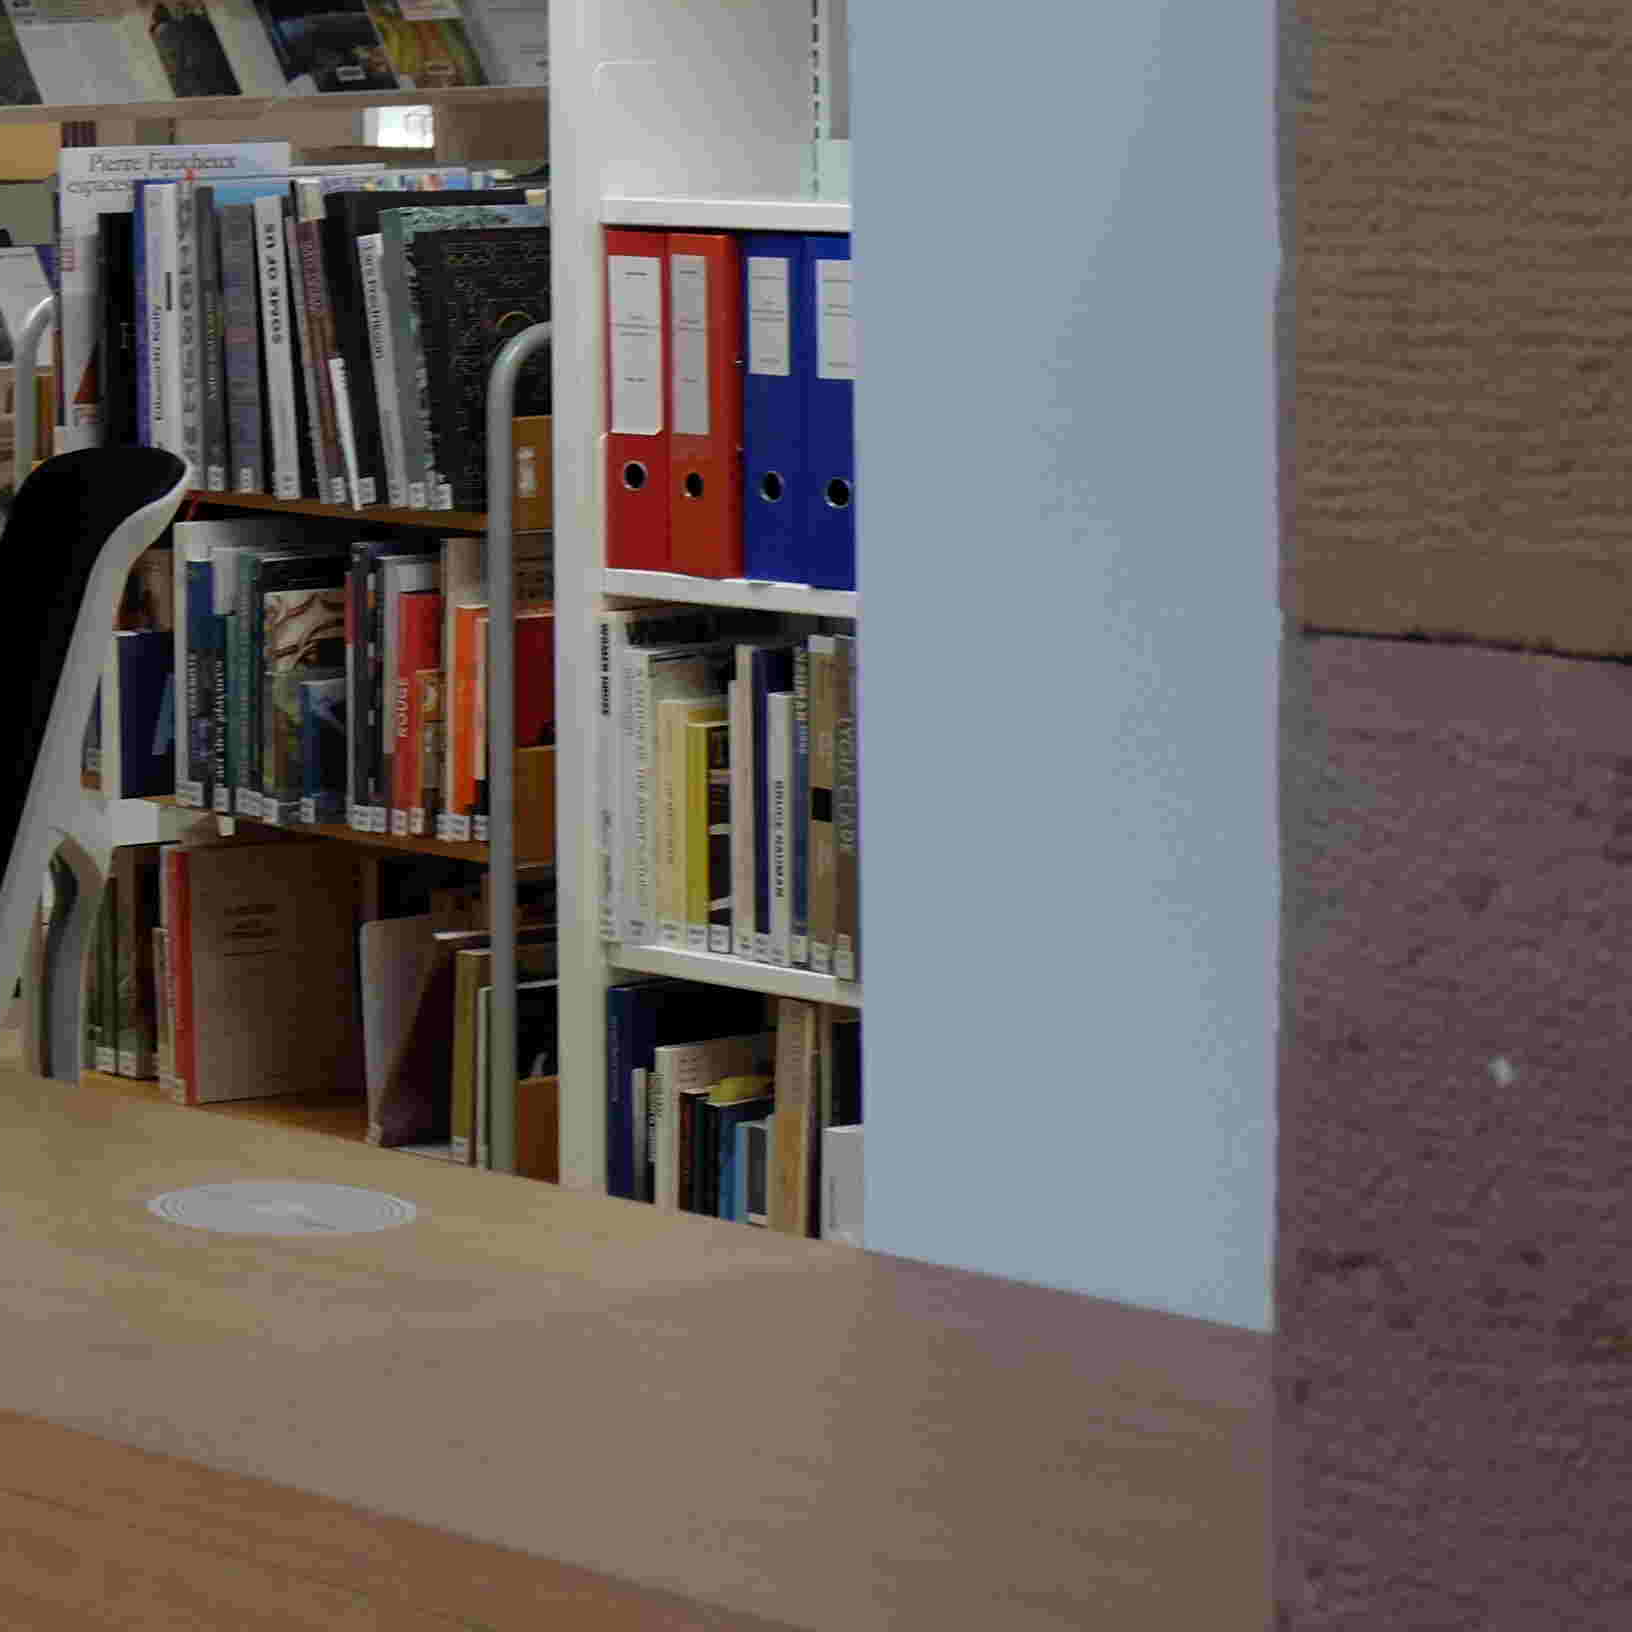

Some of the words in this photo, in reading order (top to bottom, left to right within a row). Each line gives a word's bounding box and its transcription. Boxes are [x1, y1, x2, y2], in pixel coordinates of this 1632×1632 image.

[89, 153, 142, 173] Pierre
[265, 223, 277, 248] US
[267, 256, 279, 280] OF
[269, 288, 281, 344] SOME
